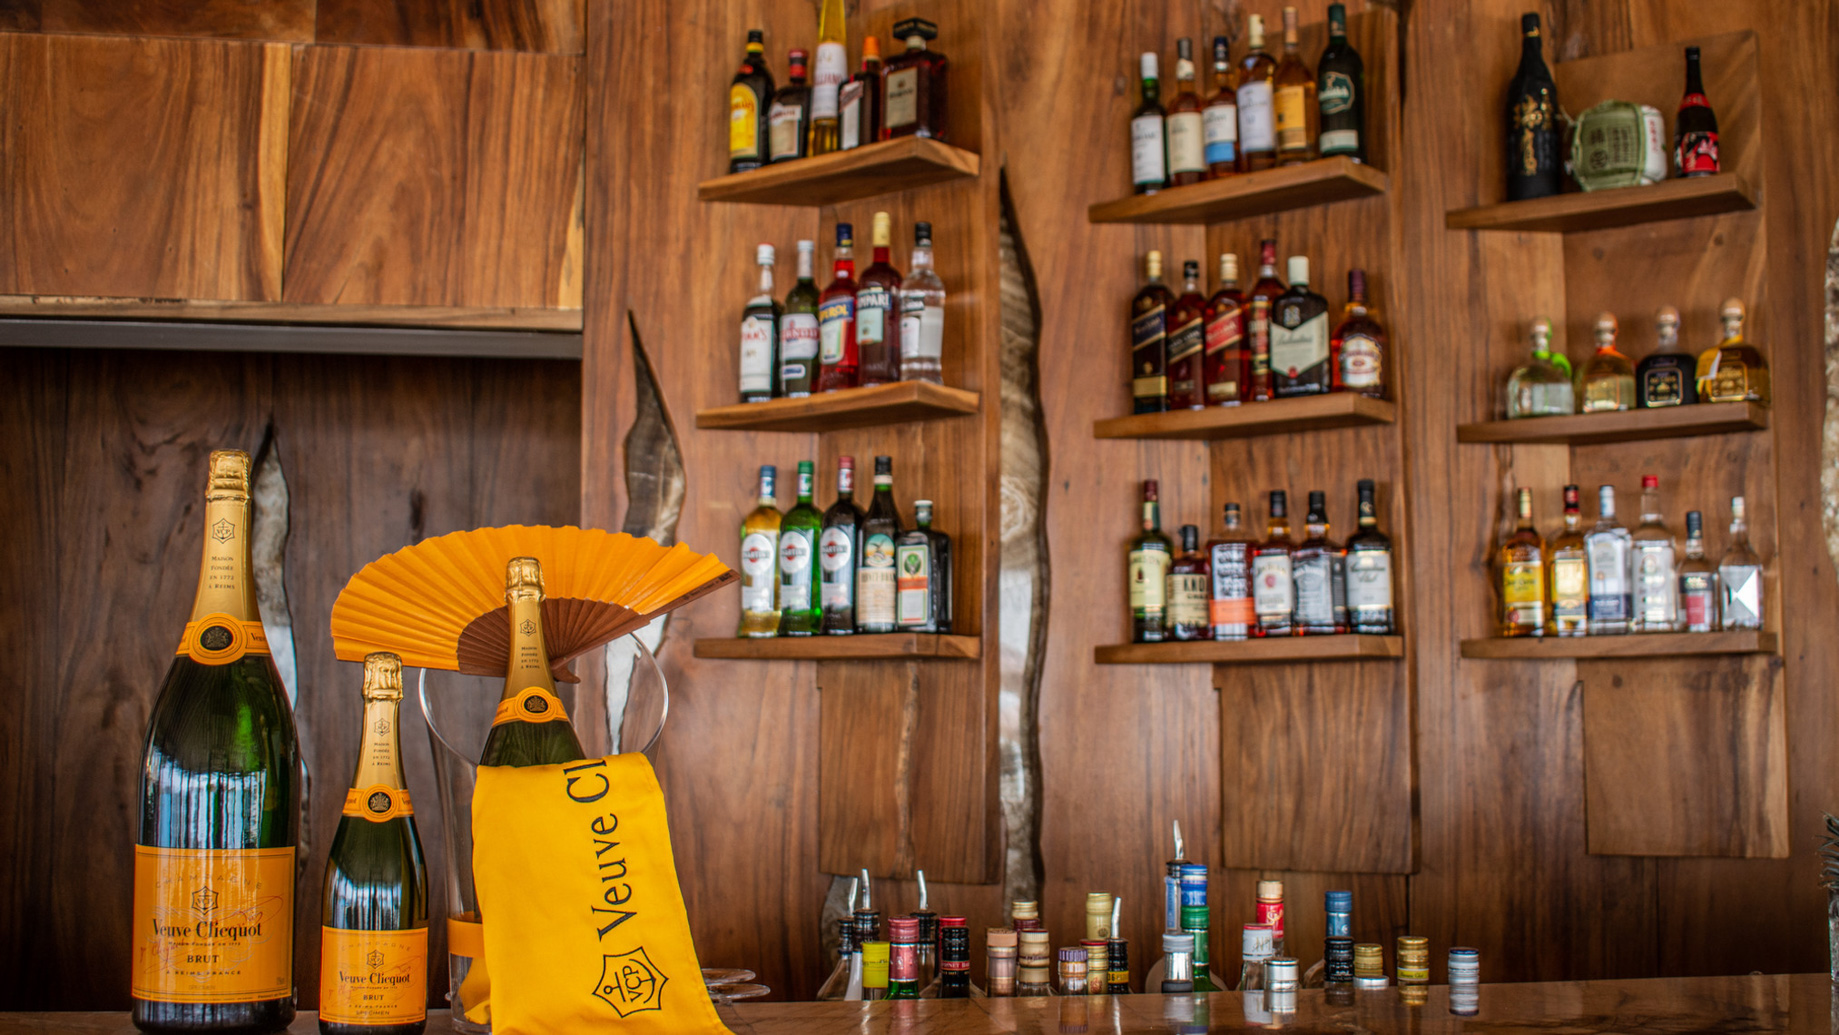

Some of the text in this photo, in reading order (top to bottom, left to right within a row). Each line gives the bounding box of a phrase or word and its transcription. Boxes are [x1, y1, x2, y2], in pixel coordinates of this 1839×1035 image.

[155, 873, 262, 890] CHAMPAGNE
[591, 813, 638, 942] Veuve
[152, 919, 262, 941] Veuve Clicquot
[187, 954, 220, 964] BRUT
[339, 971, 410, 986] Veuve Clicquot
[622, 963, 644, 1003] VCP
